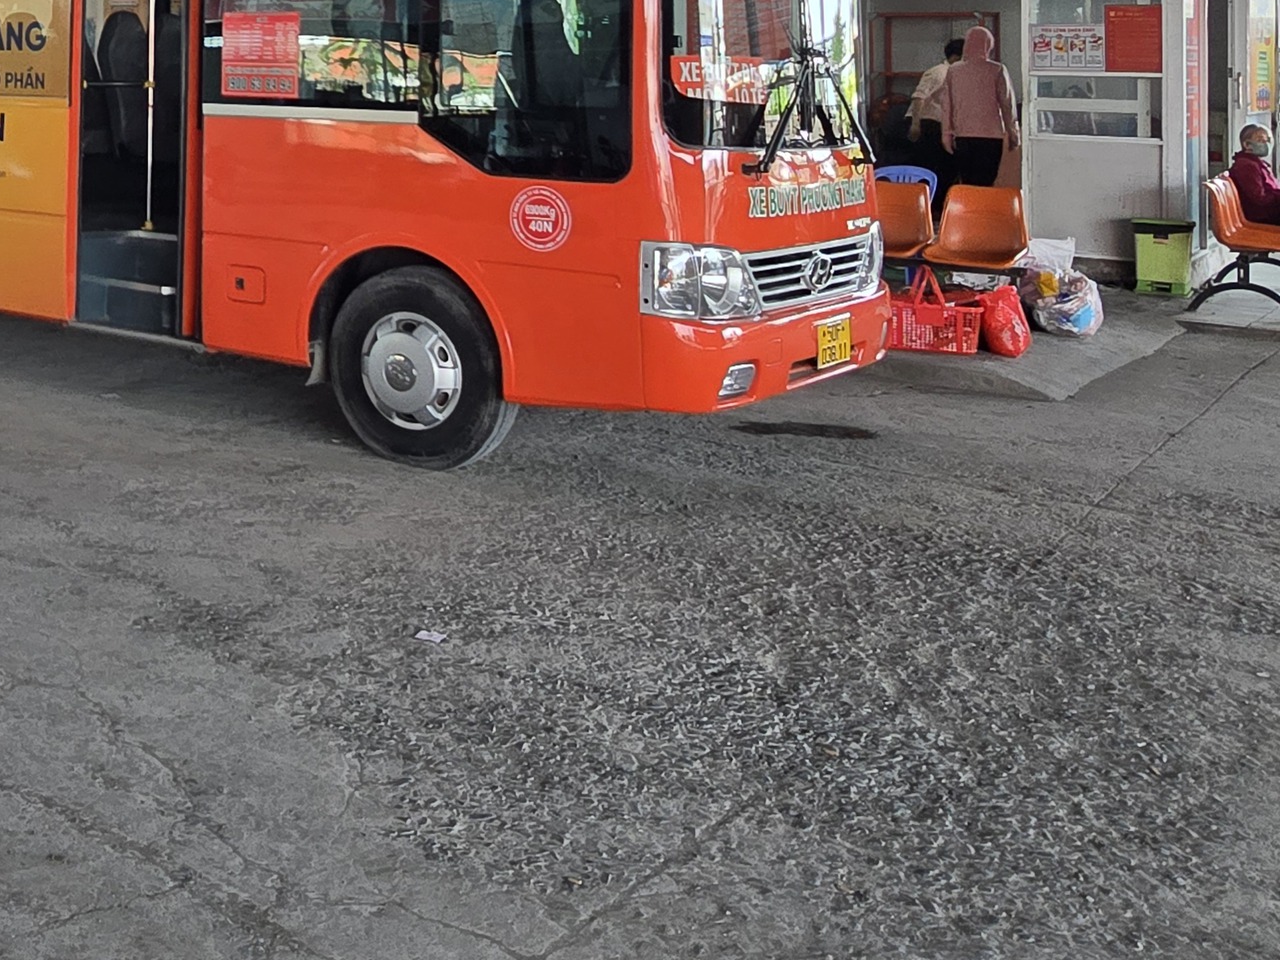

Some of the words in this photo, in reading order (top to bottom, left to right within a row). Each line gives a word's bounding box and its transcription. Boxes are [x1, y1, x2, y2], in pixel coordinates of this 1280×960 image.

[5, 66, 45, 89] PHẦN
[680, 61, 701, 82] XE
[748, 186, 767, 218] XE
[529, 220, 553, 238] 40N
